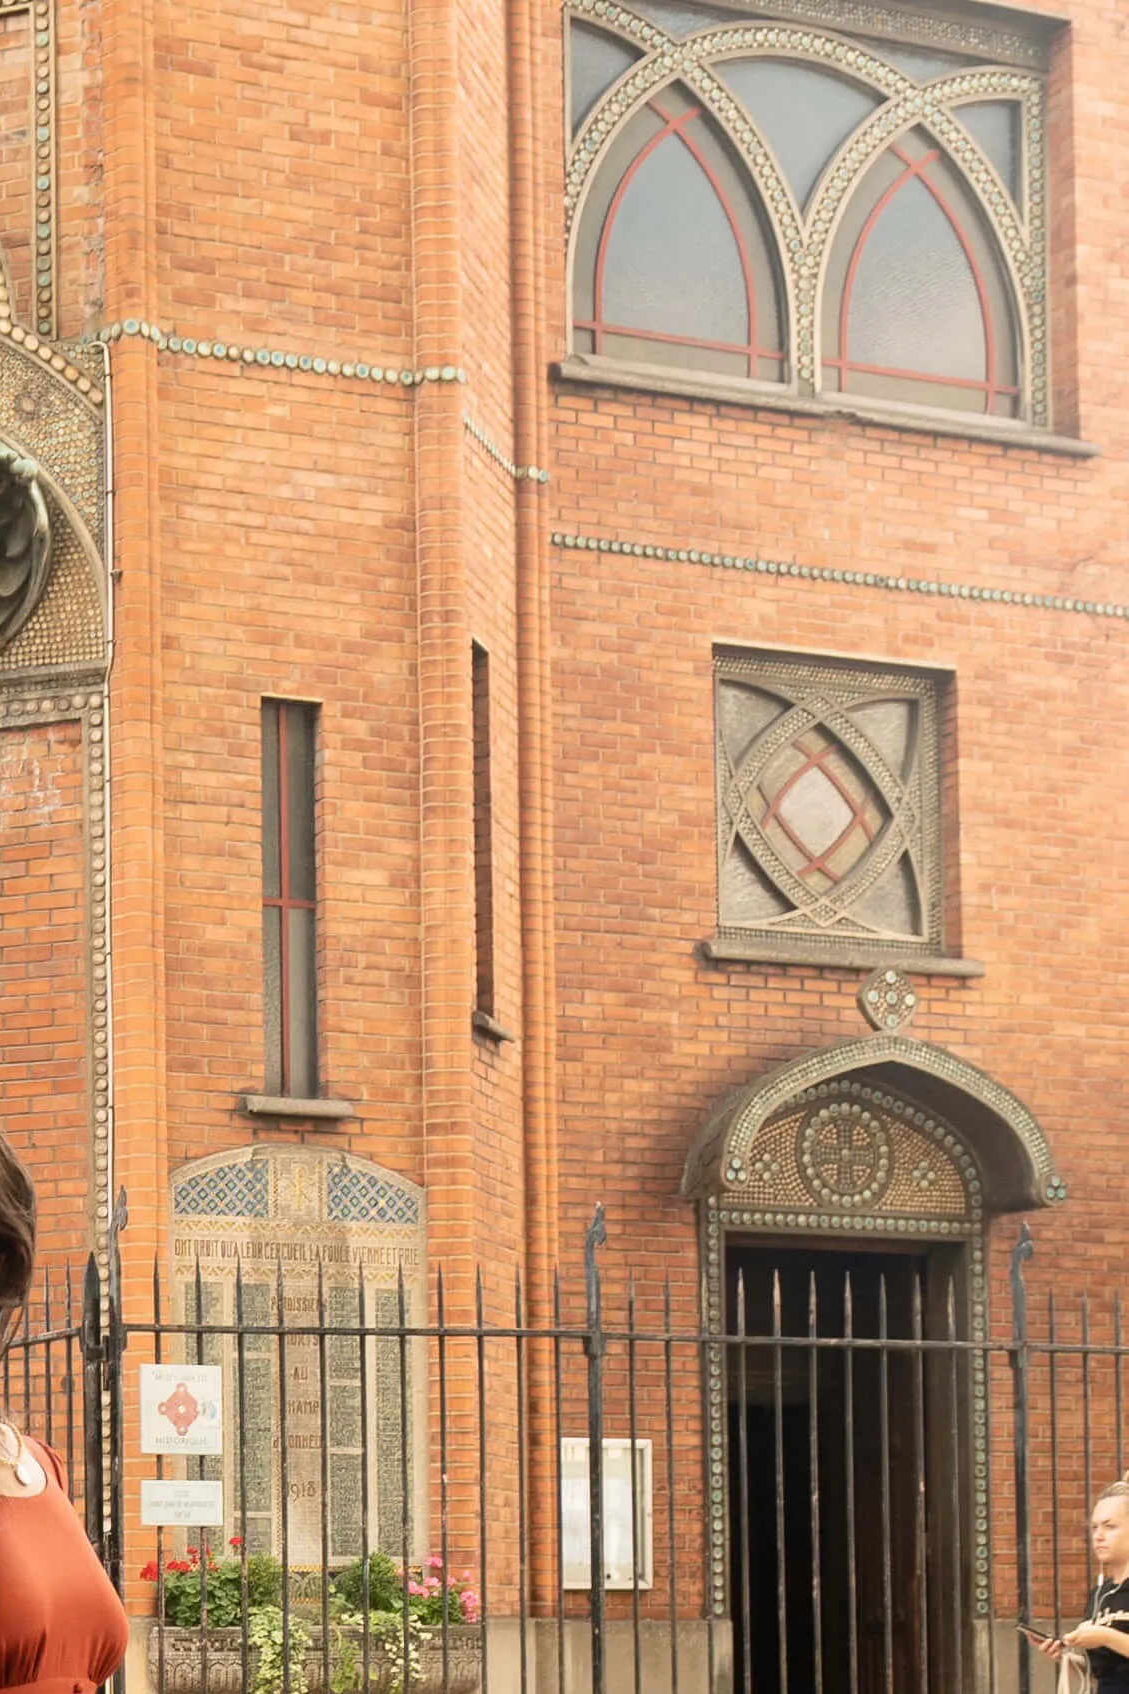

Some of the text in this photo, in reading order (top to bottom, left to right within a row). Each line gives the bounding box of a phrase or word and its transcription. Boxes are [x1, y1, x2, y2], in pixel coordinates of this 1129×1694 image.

[241, 1241, 263, 1260] LEUR
[309, 1243, 320, 1261] LA
[322, 1244, 350, 1263] FOULE
[386, 1247, 396, 1265] ET
[399, 1248, 419, 1266] PRIE
[293, 1366, 309, 1381] AU
[287, 1399, 320, 1415] HAMP
